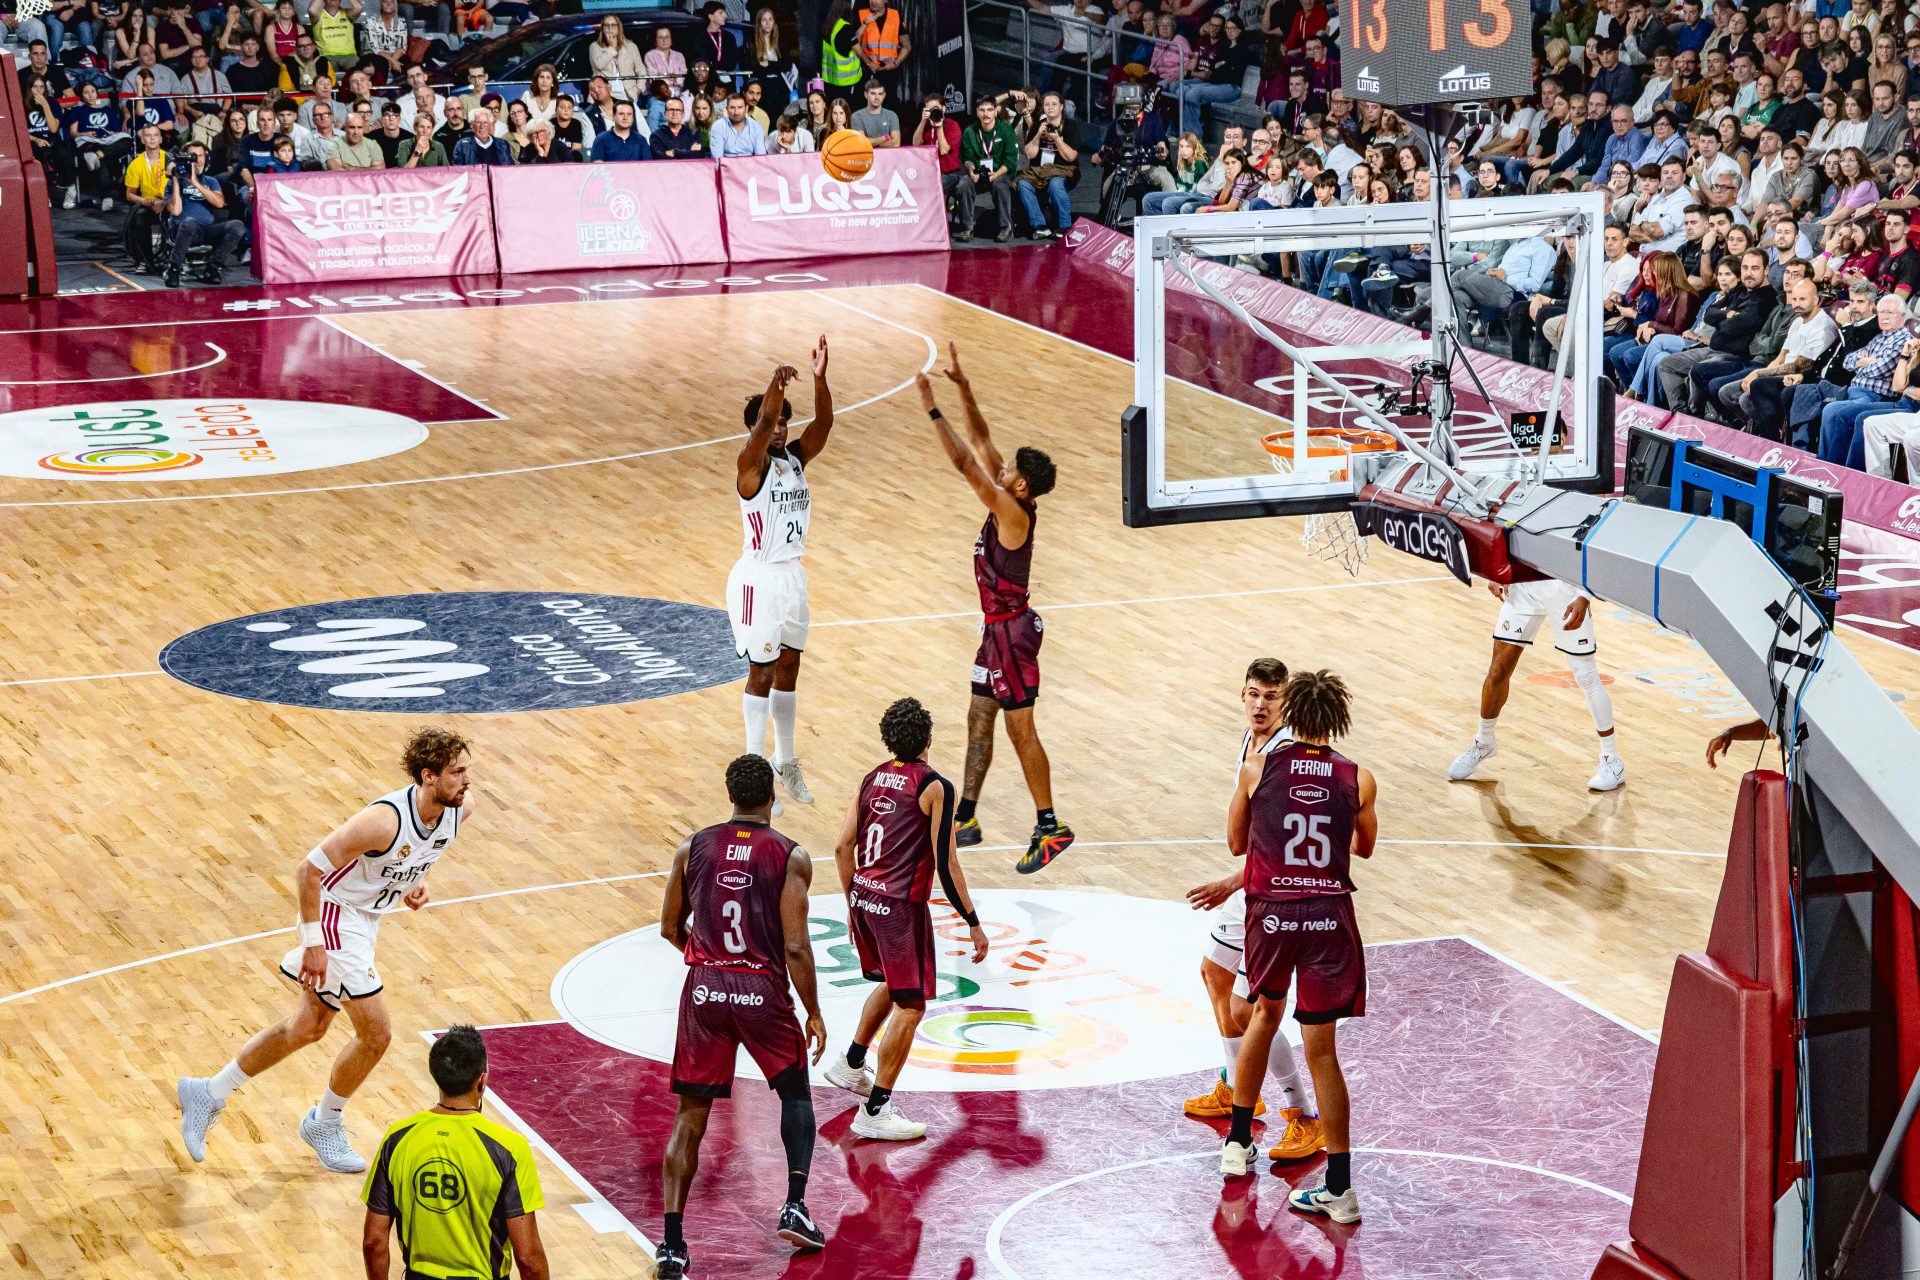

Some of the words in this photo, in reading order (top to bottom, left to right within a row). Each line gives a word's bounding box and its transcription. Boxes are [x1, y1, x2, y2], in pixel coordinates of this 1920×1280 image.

[1357, 78, 1380, 93] LOTUS
[1438, 76, 1491, 93] LOTUS
[319, 195, 432, 221] GAHER
[829, 216, 847, 229] The
[848, 216, 872, 228] new
[868, 213, 920, 229] agriculture
[317, 245, 382, 258] MAQUINARIA
[383, 242, 436, 256] AGRÍCOLA
[318, 258, 375, 270] TRABAJOS
[377, 254, 451, 268] INDUSTRIALES
[222, 273, 830, 313] #ligaendesa
[1512, 422, 1535, 436] liga
[1511, 431, 1560, 446] endea
[786, 519, 803, 544] 24
[1384, 512, 1454, 569] endesa
[510, 633, 612, 685] Clínica
[1290, 759, 1333, 777] PERRIN
[872, 771, 909, 792] MCGHEE
[1295, 789, 1324, 798] ownat
[864, 822, 885, 868] 0
[1283, 812, 1332, 869] 25
[725, 844, 753, 862] EJIM
[722, 875, 748, 884] ownat
[722, 899, 748, 954] 3
[419, 1171, 460, 1201] 68
